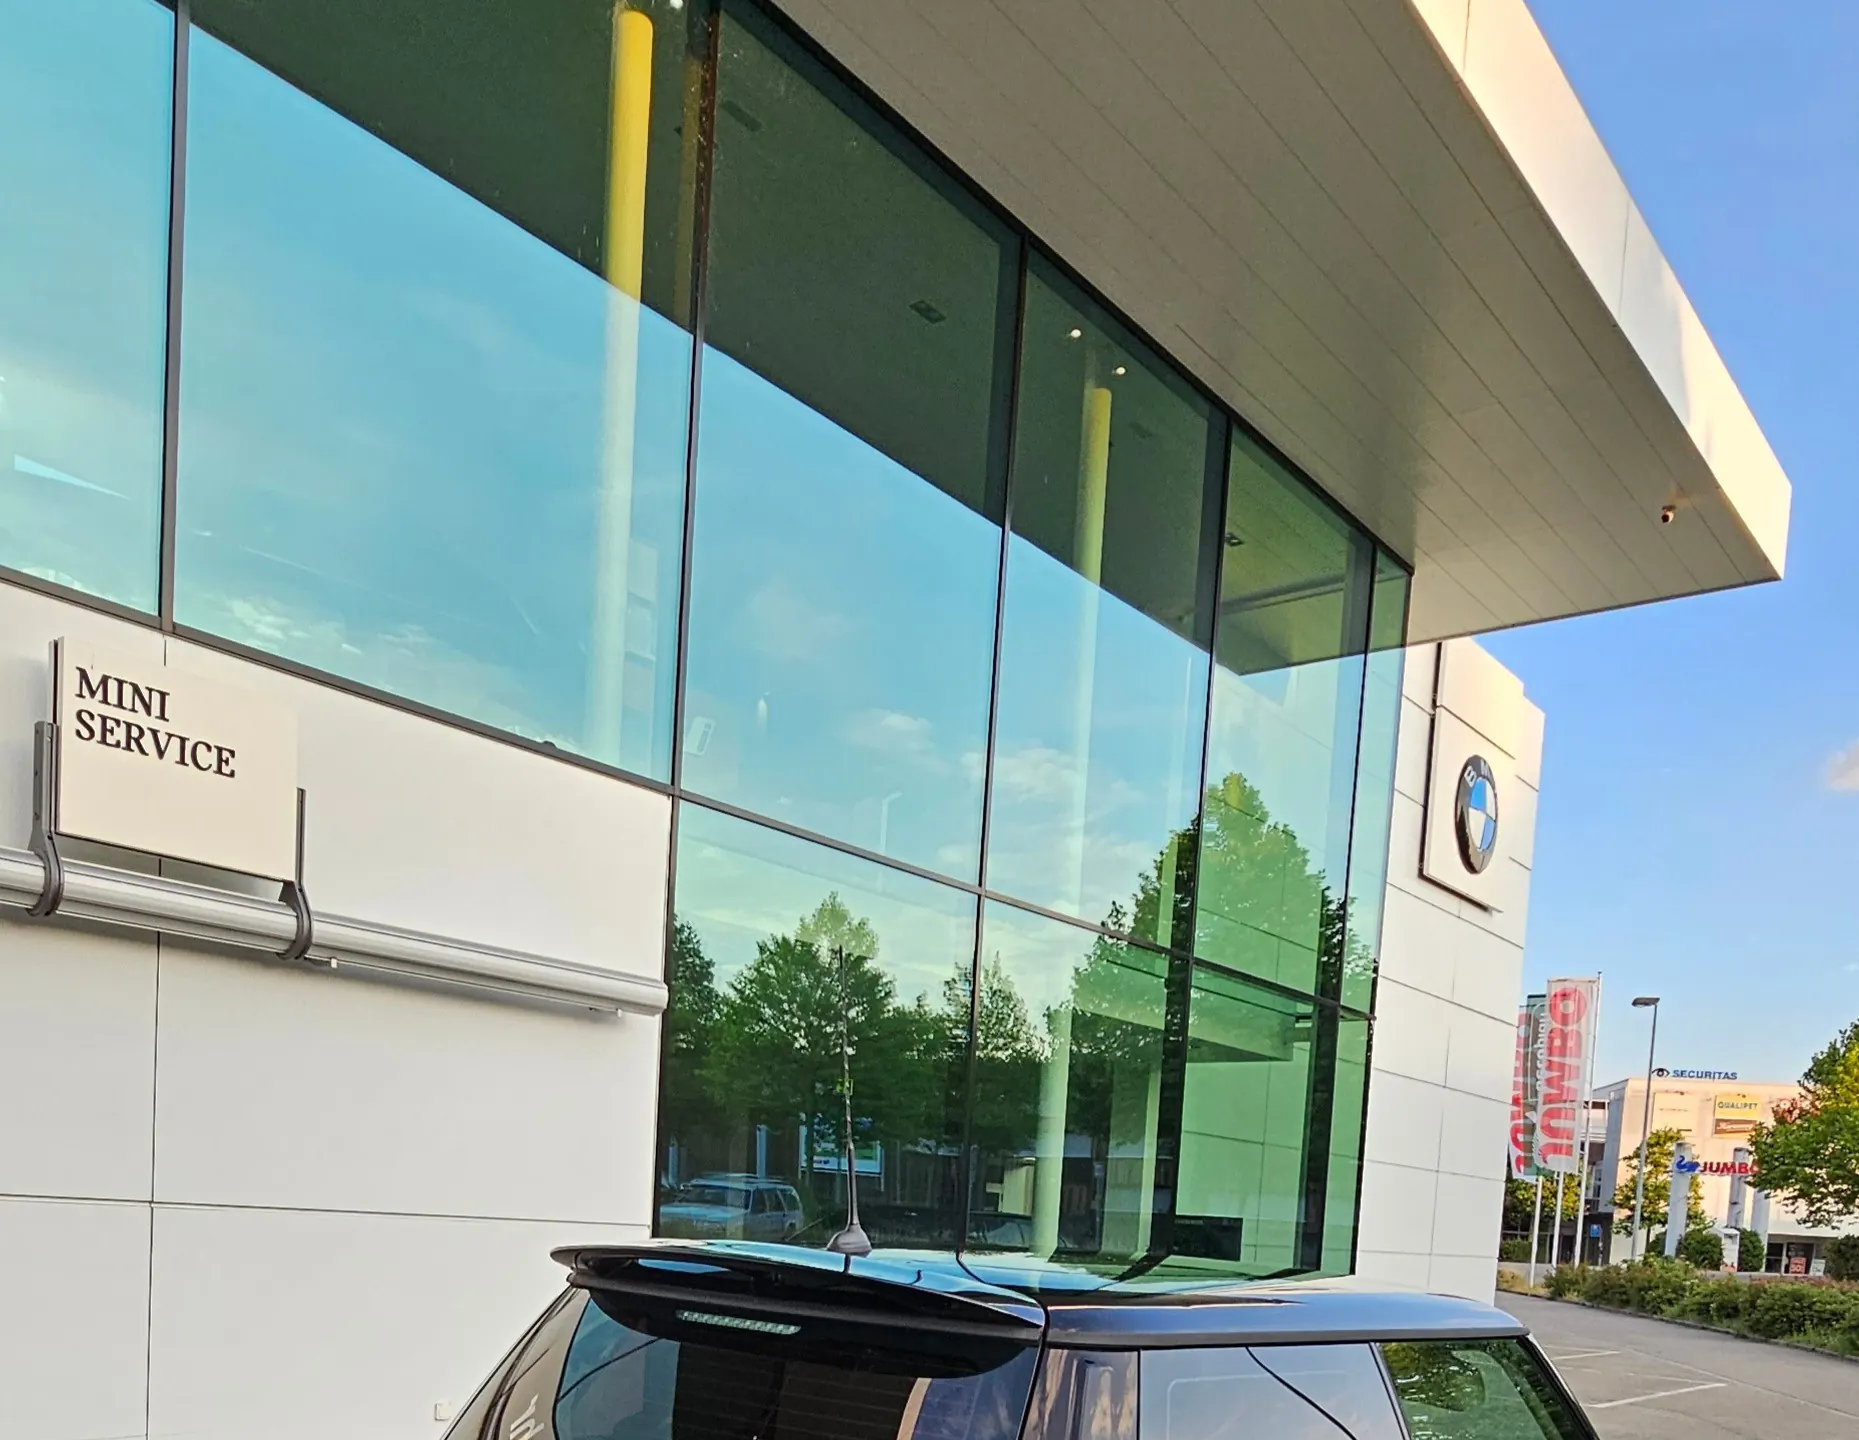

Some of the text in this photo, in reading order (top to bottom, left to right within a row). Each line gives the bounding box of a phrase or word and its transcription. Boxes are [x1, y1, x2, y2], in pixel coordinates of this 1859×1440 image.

[75, 666, 170, 722] MINI
[75, 709, 236, 778] SERVICE
[1672, 1069, 1738, 1081] SECURITAS
[1717, 1101, 1759, 1110] QUALIPET
